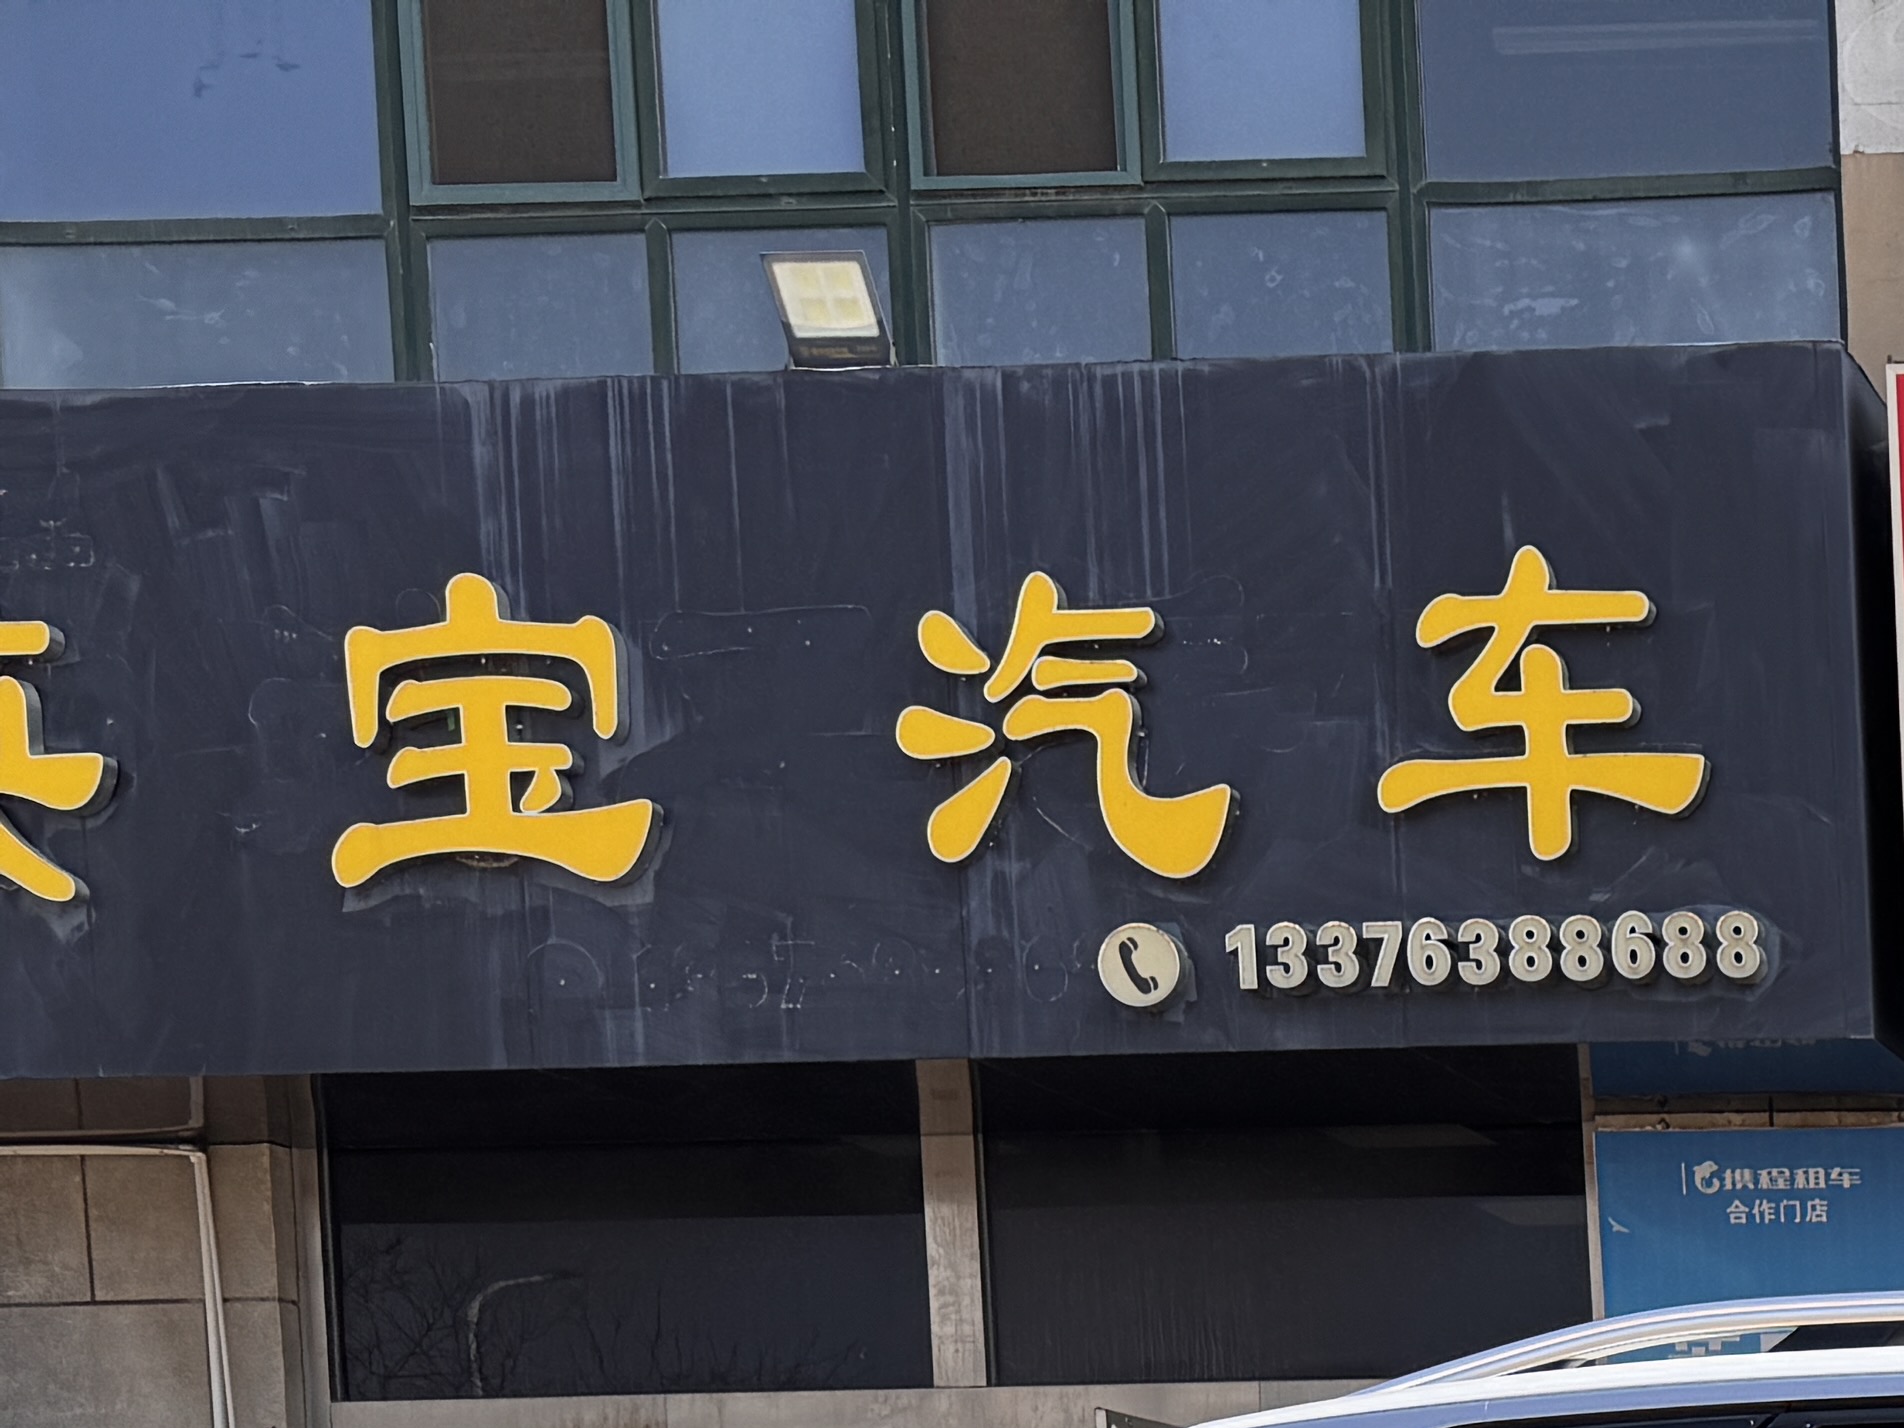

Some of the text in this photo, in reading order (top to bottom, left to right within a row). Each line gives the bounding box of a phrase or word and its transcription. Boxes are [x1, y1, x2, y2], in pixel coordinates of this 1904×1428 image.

[1224, 909, 1765, 992] 13376388688
[1722, 1166, 1863, 1191] 携程租车
[1725, 1198, 1828, 1225] 合作门店
